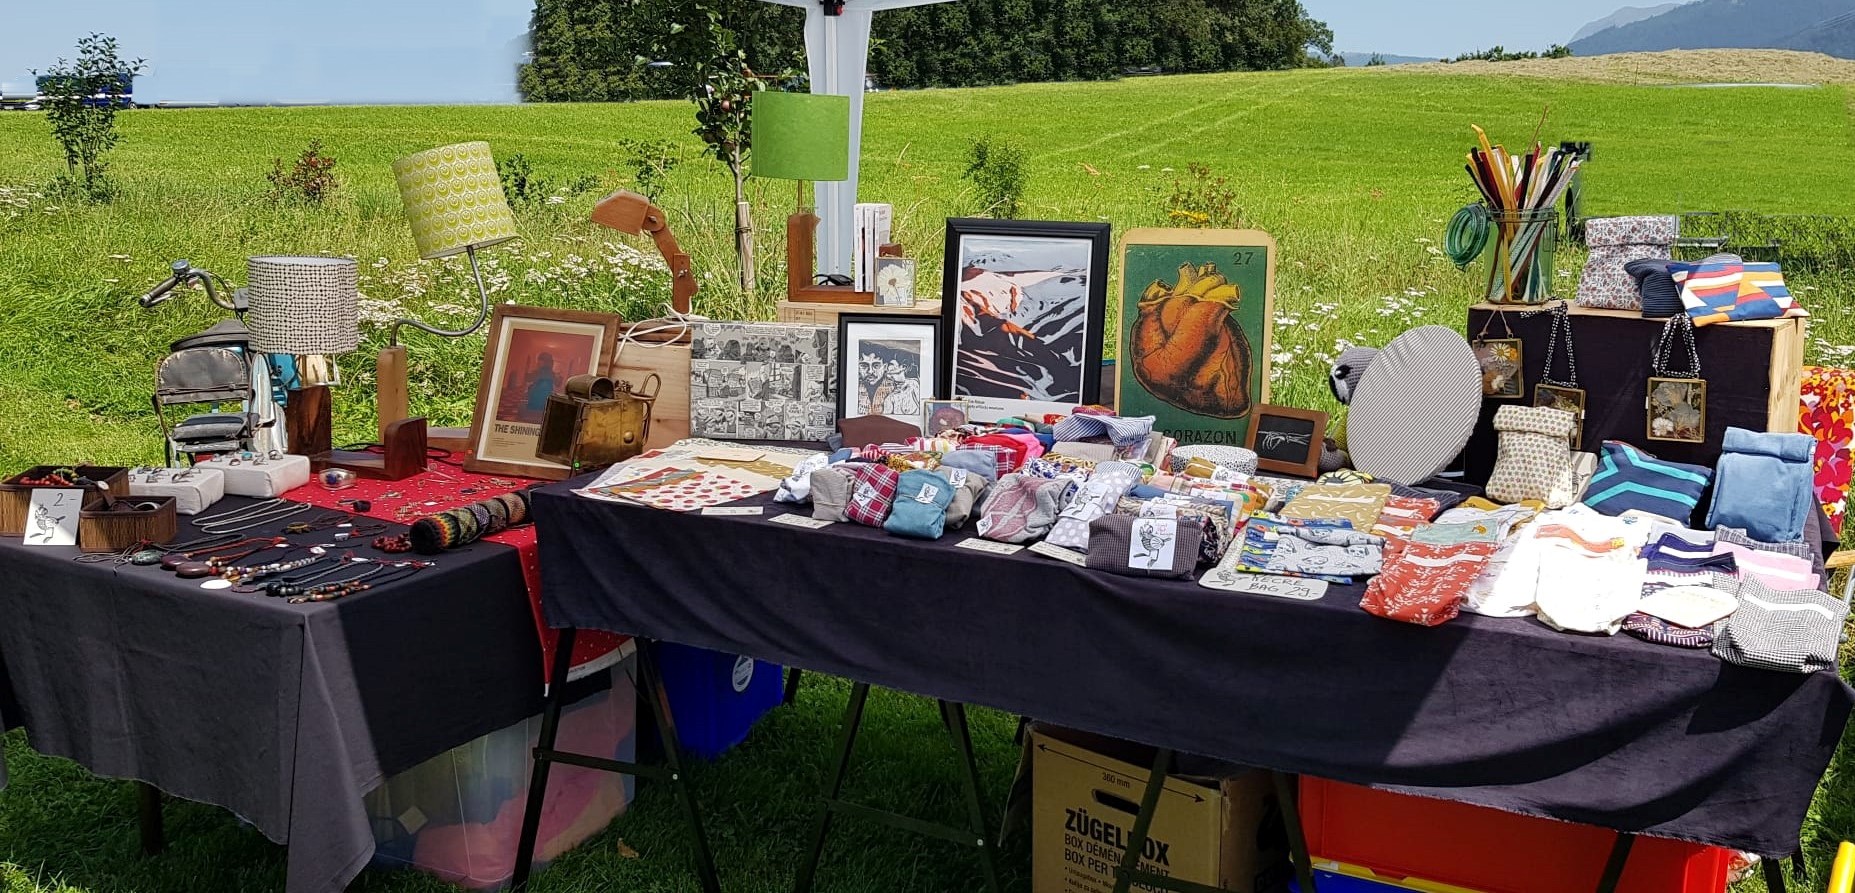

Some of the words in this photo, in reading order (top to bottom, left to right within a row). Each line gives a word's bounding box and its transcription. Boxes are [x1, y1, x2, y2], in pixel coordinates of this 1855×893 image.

[1233, 252, 1254, 265] 27
[494, 423, 509, 434] THE
[1245, 582, 1280, 593] BAG
[1102, 771, 1116, 783] 360
[1116, 777, 1130, 788] mm
[1065, 807, 1170, 866] ZÜGELOX
[1065, 833, 1084, 850] BOX
[1065, 848, 1085, 866] BOX
[1088, 858, 1108, 876] PER
